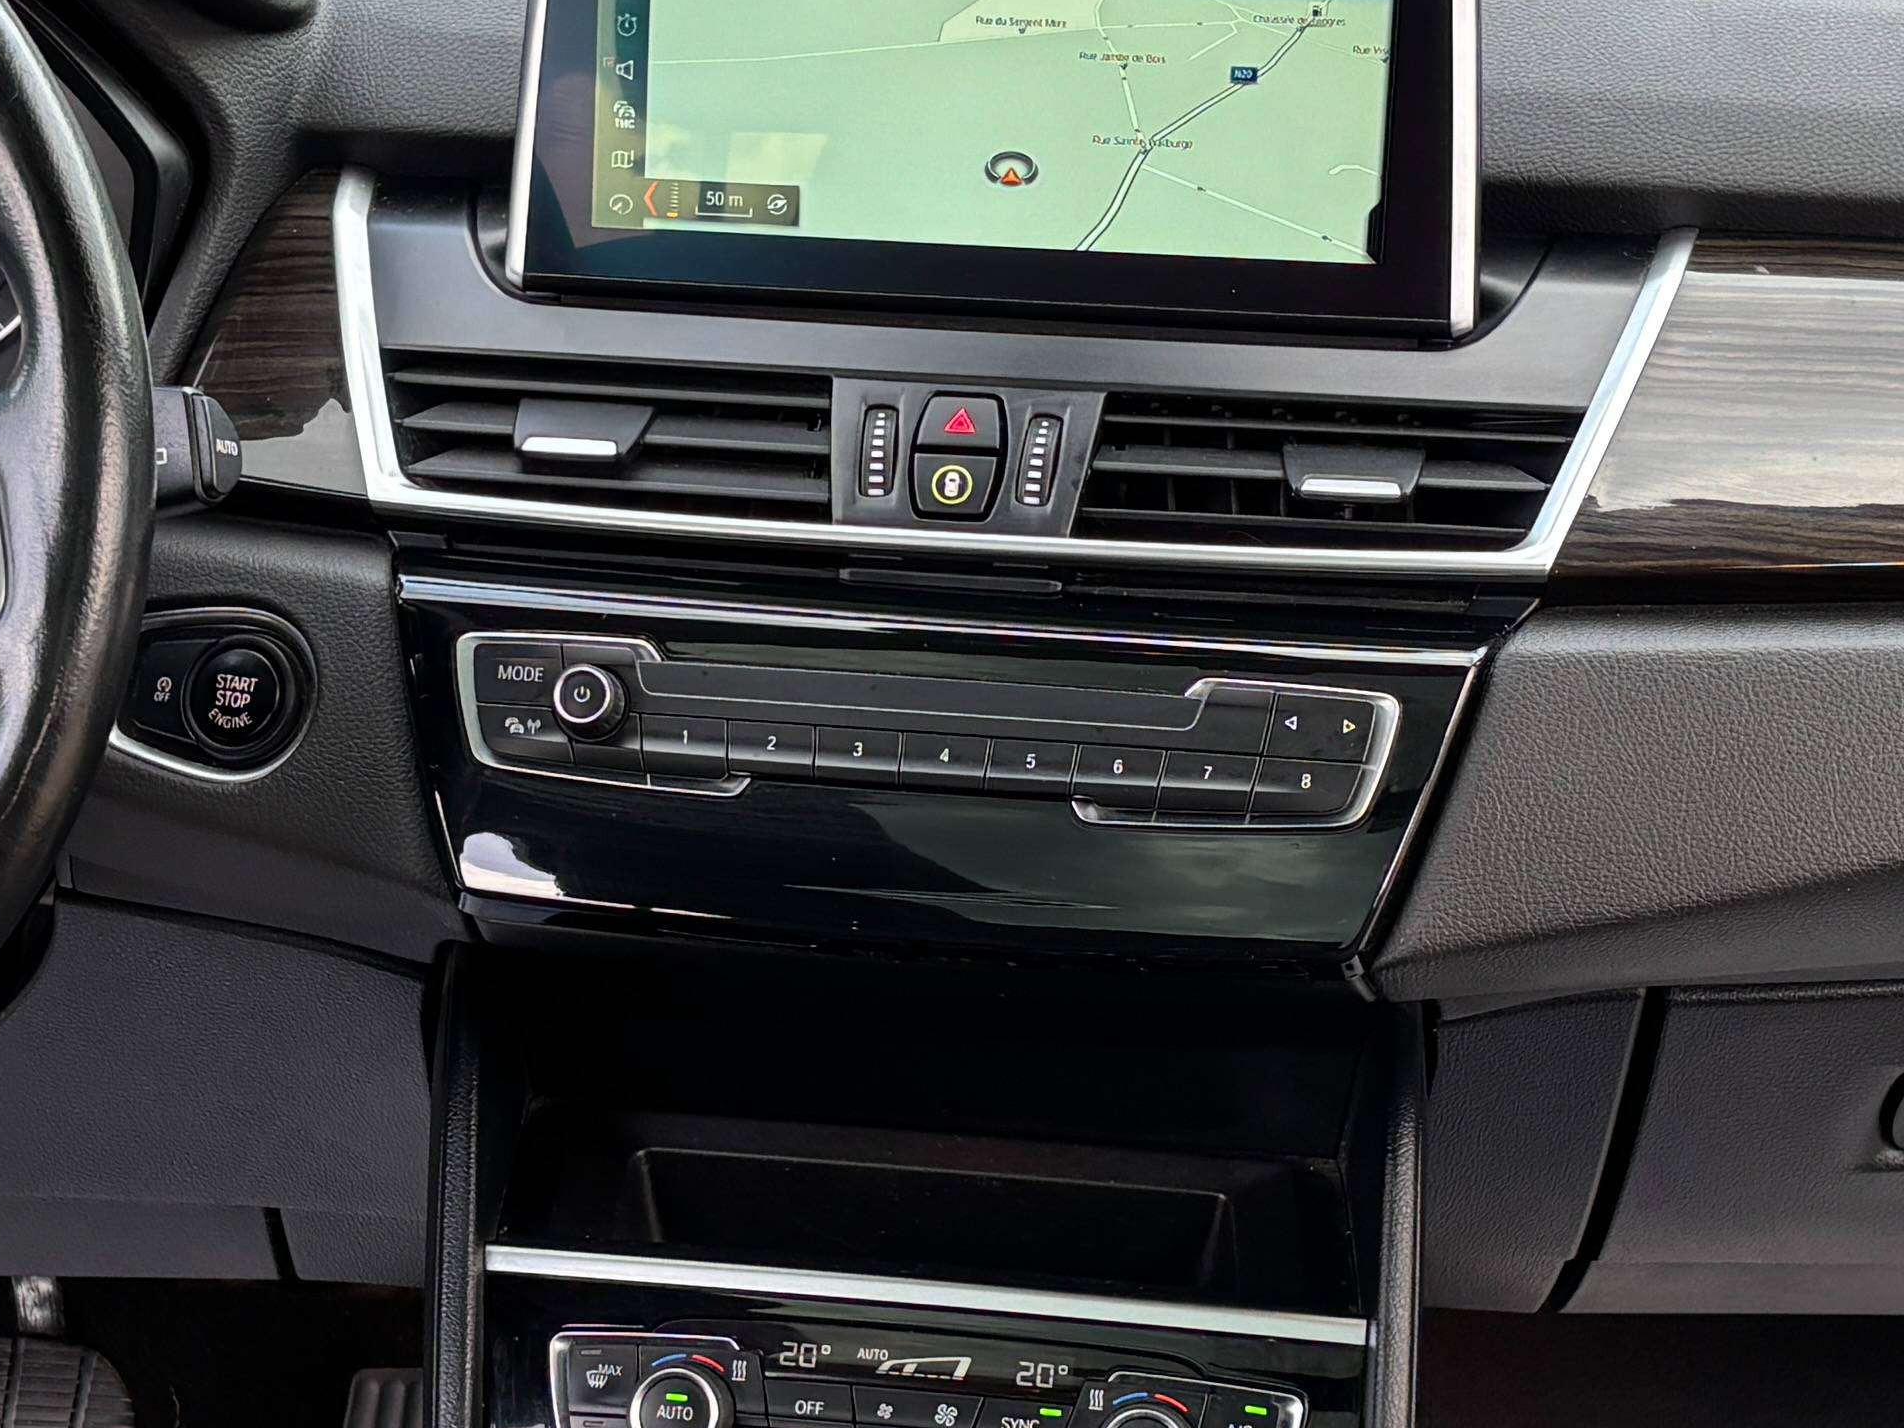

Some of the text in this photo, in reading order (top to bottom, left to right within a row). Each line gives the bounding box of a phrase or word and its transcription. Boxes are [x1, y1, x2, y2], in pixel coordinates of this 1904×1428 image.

[975, 15, 993, 25] Rue
[1079, 51, 1097, 60] Rue
[1352, 45, 1370, 55] Rue
[1092, 135, 1111, 145] Rue
[705, 191, 744, 207] 50 m
[216, 438, 239, 456] AUTO
[497, 664, 544, 684] MODE
[216, 673, 258, 692] START
[153, 691, 171, 703] OFF
[215, 690, 251, 708] STOP
[208, 708, 253, 729] ENGINE
[682, 730, 689, 745] 1
[766, 735, 777, 751] 2
[853, 742, 863, 757] 3
[939, 747, 949, 763] 4
[1025, 753, 1037, 770] 5
[1113, 758, 1123, 774] 6
[1204, 765, 1214, 781] 7
[1301, 773, 1312, 789] 8
[779, 1341, 831, 1369] 20°
[856, 1347, 889, 1361] AUTO
[598, 1363, 623, 1377] MAX
[1015, 1360, 1069, 1389] 20°
[656, 1405, 694, 1422] AUTO
[795, 1399, 825, 1416] OFF
